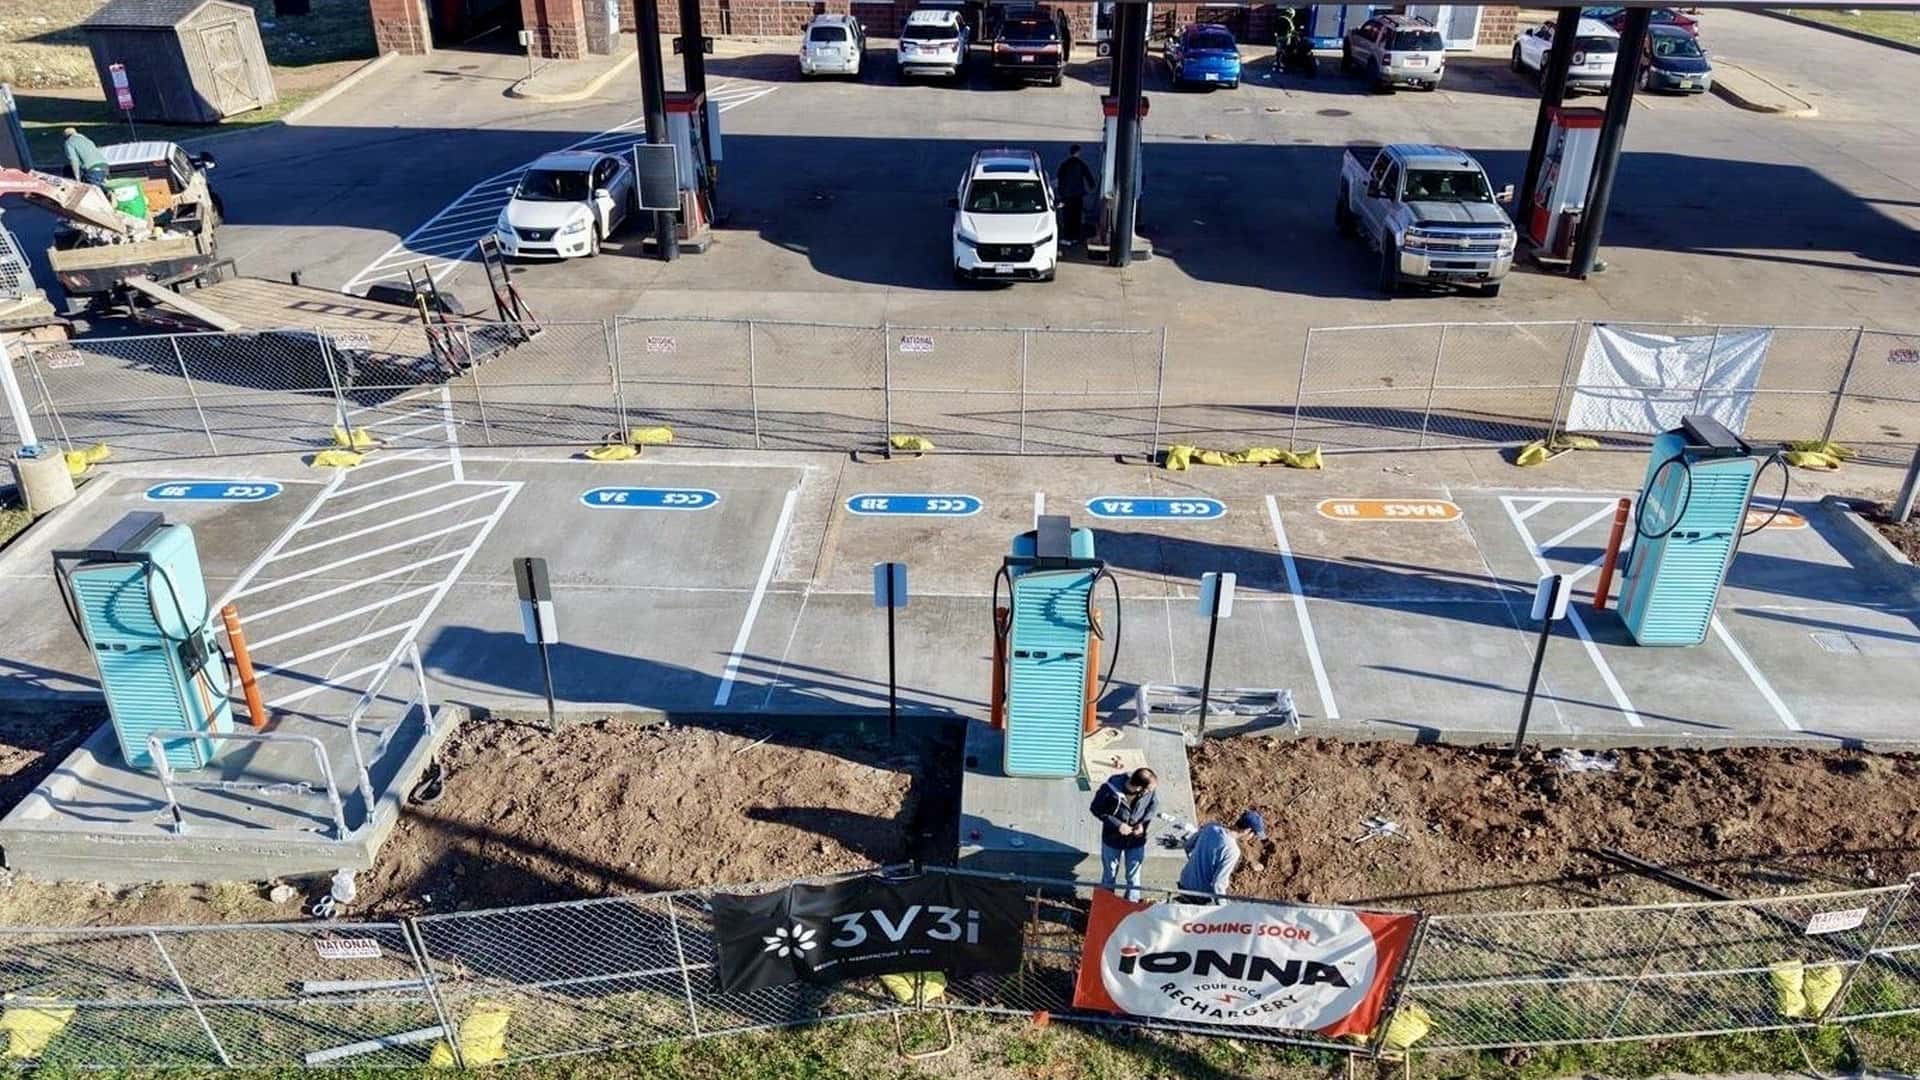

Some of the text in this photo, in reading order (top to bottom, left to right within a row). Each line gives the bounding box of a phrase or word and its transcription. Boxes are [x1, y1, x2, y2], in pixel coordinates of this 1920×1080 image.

[222, 485, 266, 497] CCS
[599, 491, 704, 504] CCS 3A
[860, 498, 966, 511] CCS 2B
[1101, 501, 1210, 514] CCS 2A
[1382, 503, 1446, 516] NACS
[1182, 922, 1311, 940] COMING SOON
[315, 940, 377, 950] NATIONAL
[1193, 983, 1263, 1001] YOUR LOCA
[1159, 981, 1299, 1019] RECHARGERY
